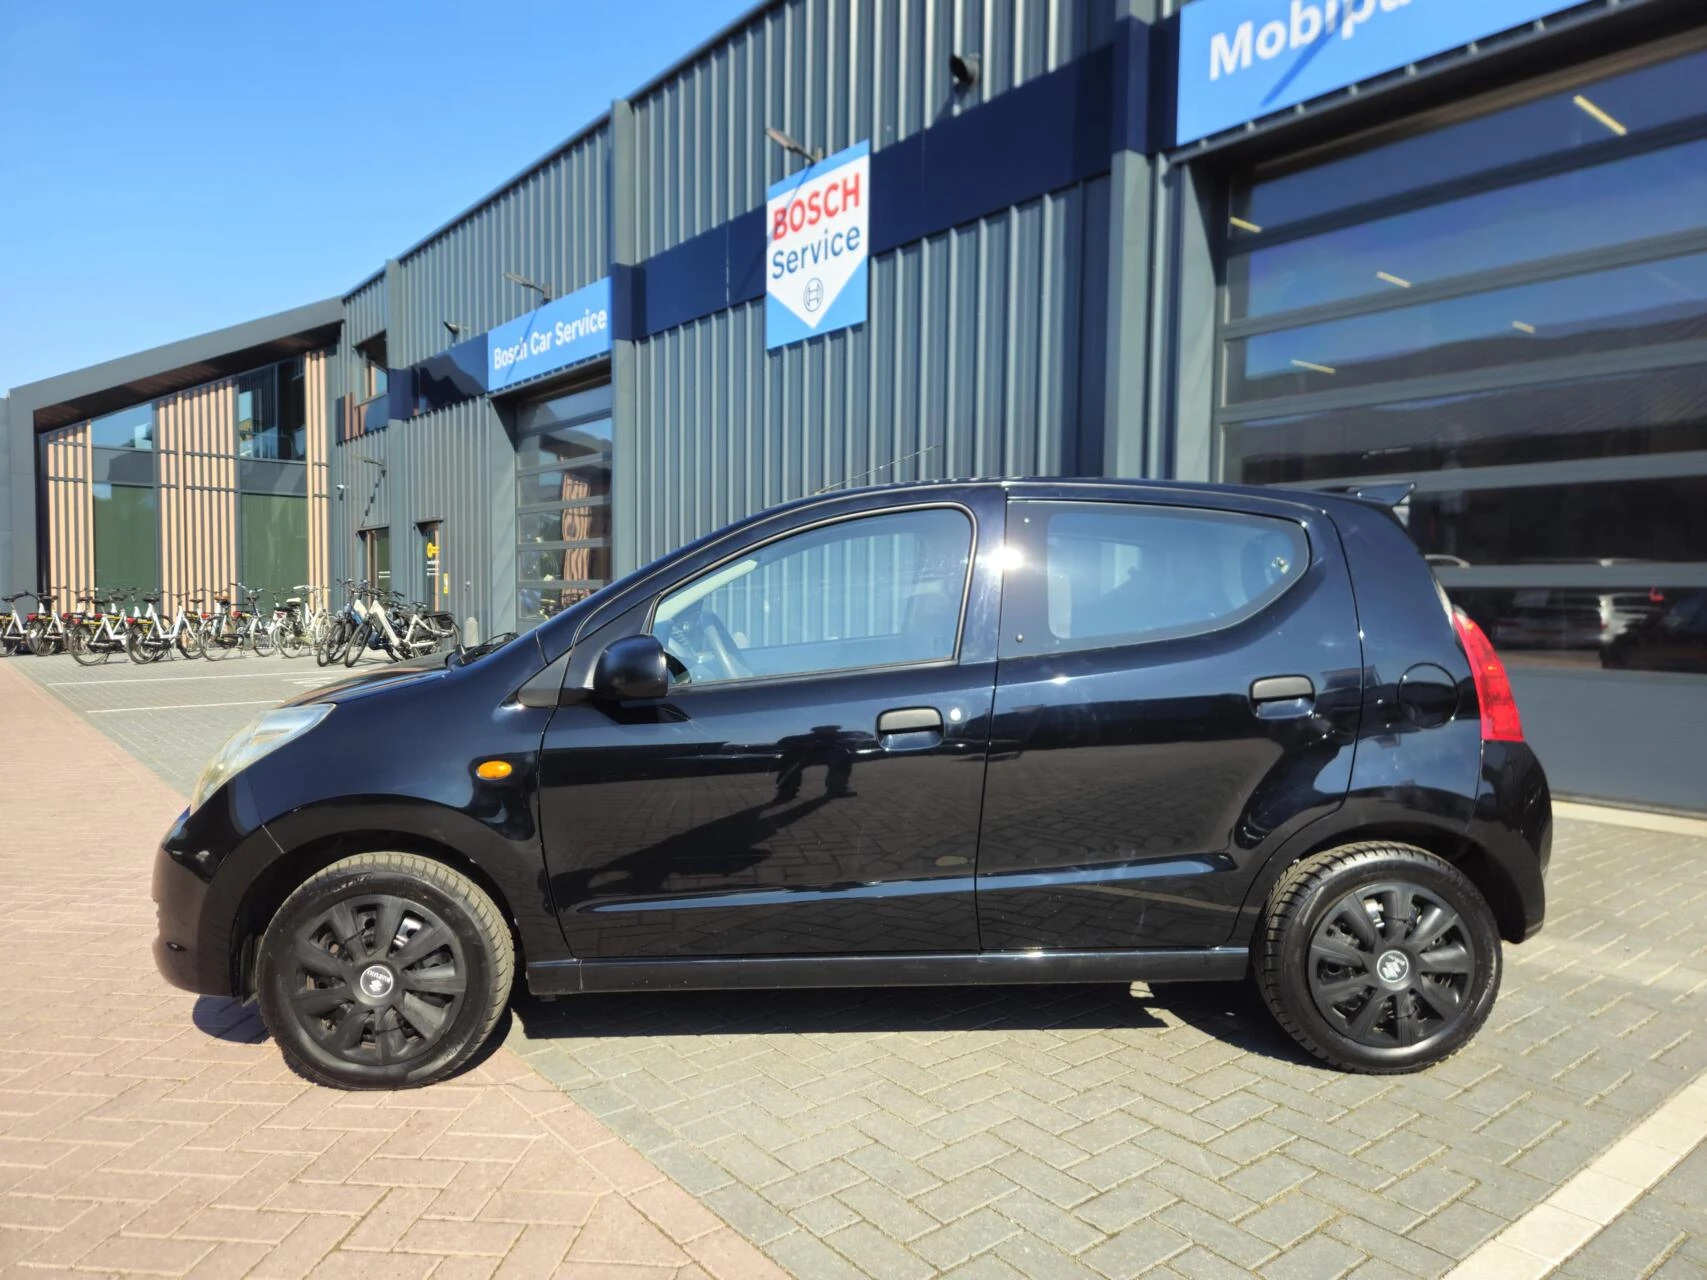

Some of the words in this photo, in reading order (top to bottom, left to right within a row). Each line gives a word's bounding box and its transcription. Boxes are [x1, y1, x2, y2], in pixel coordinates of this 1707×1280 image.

[773, 172, 860, 240] BOSCH
[772, 226, 861, 279] Service
[494, 337, 528, 370] Bosch
[530, 331, 553, 355] Car
[555, 308, 608, 346] Service
